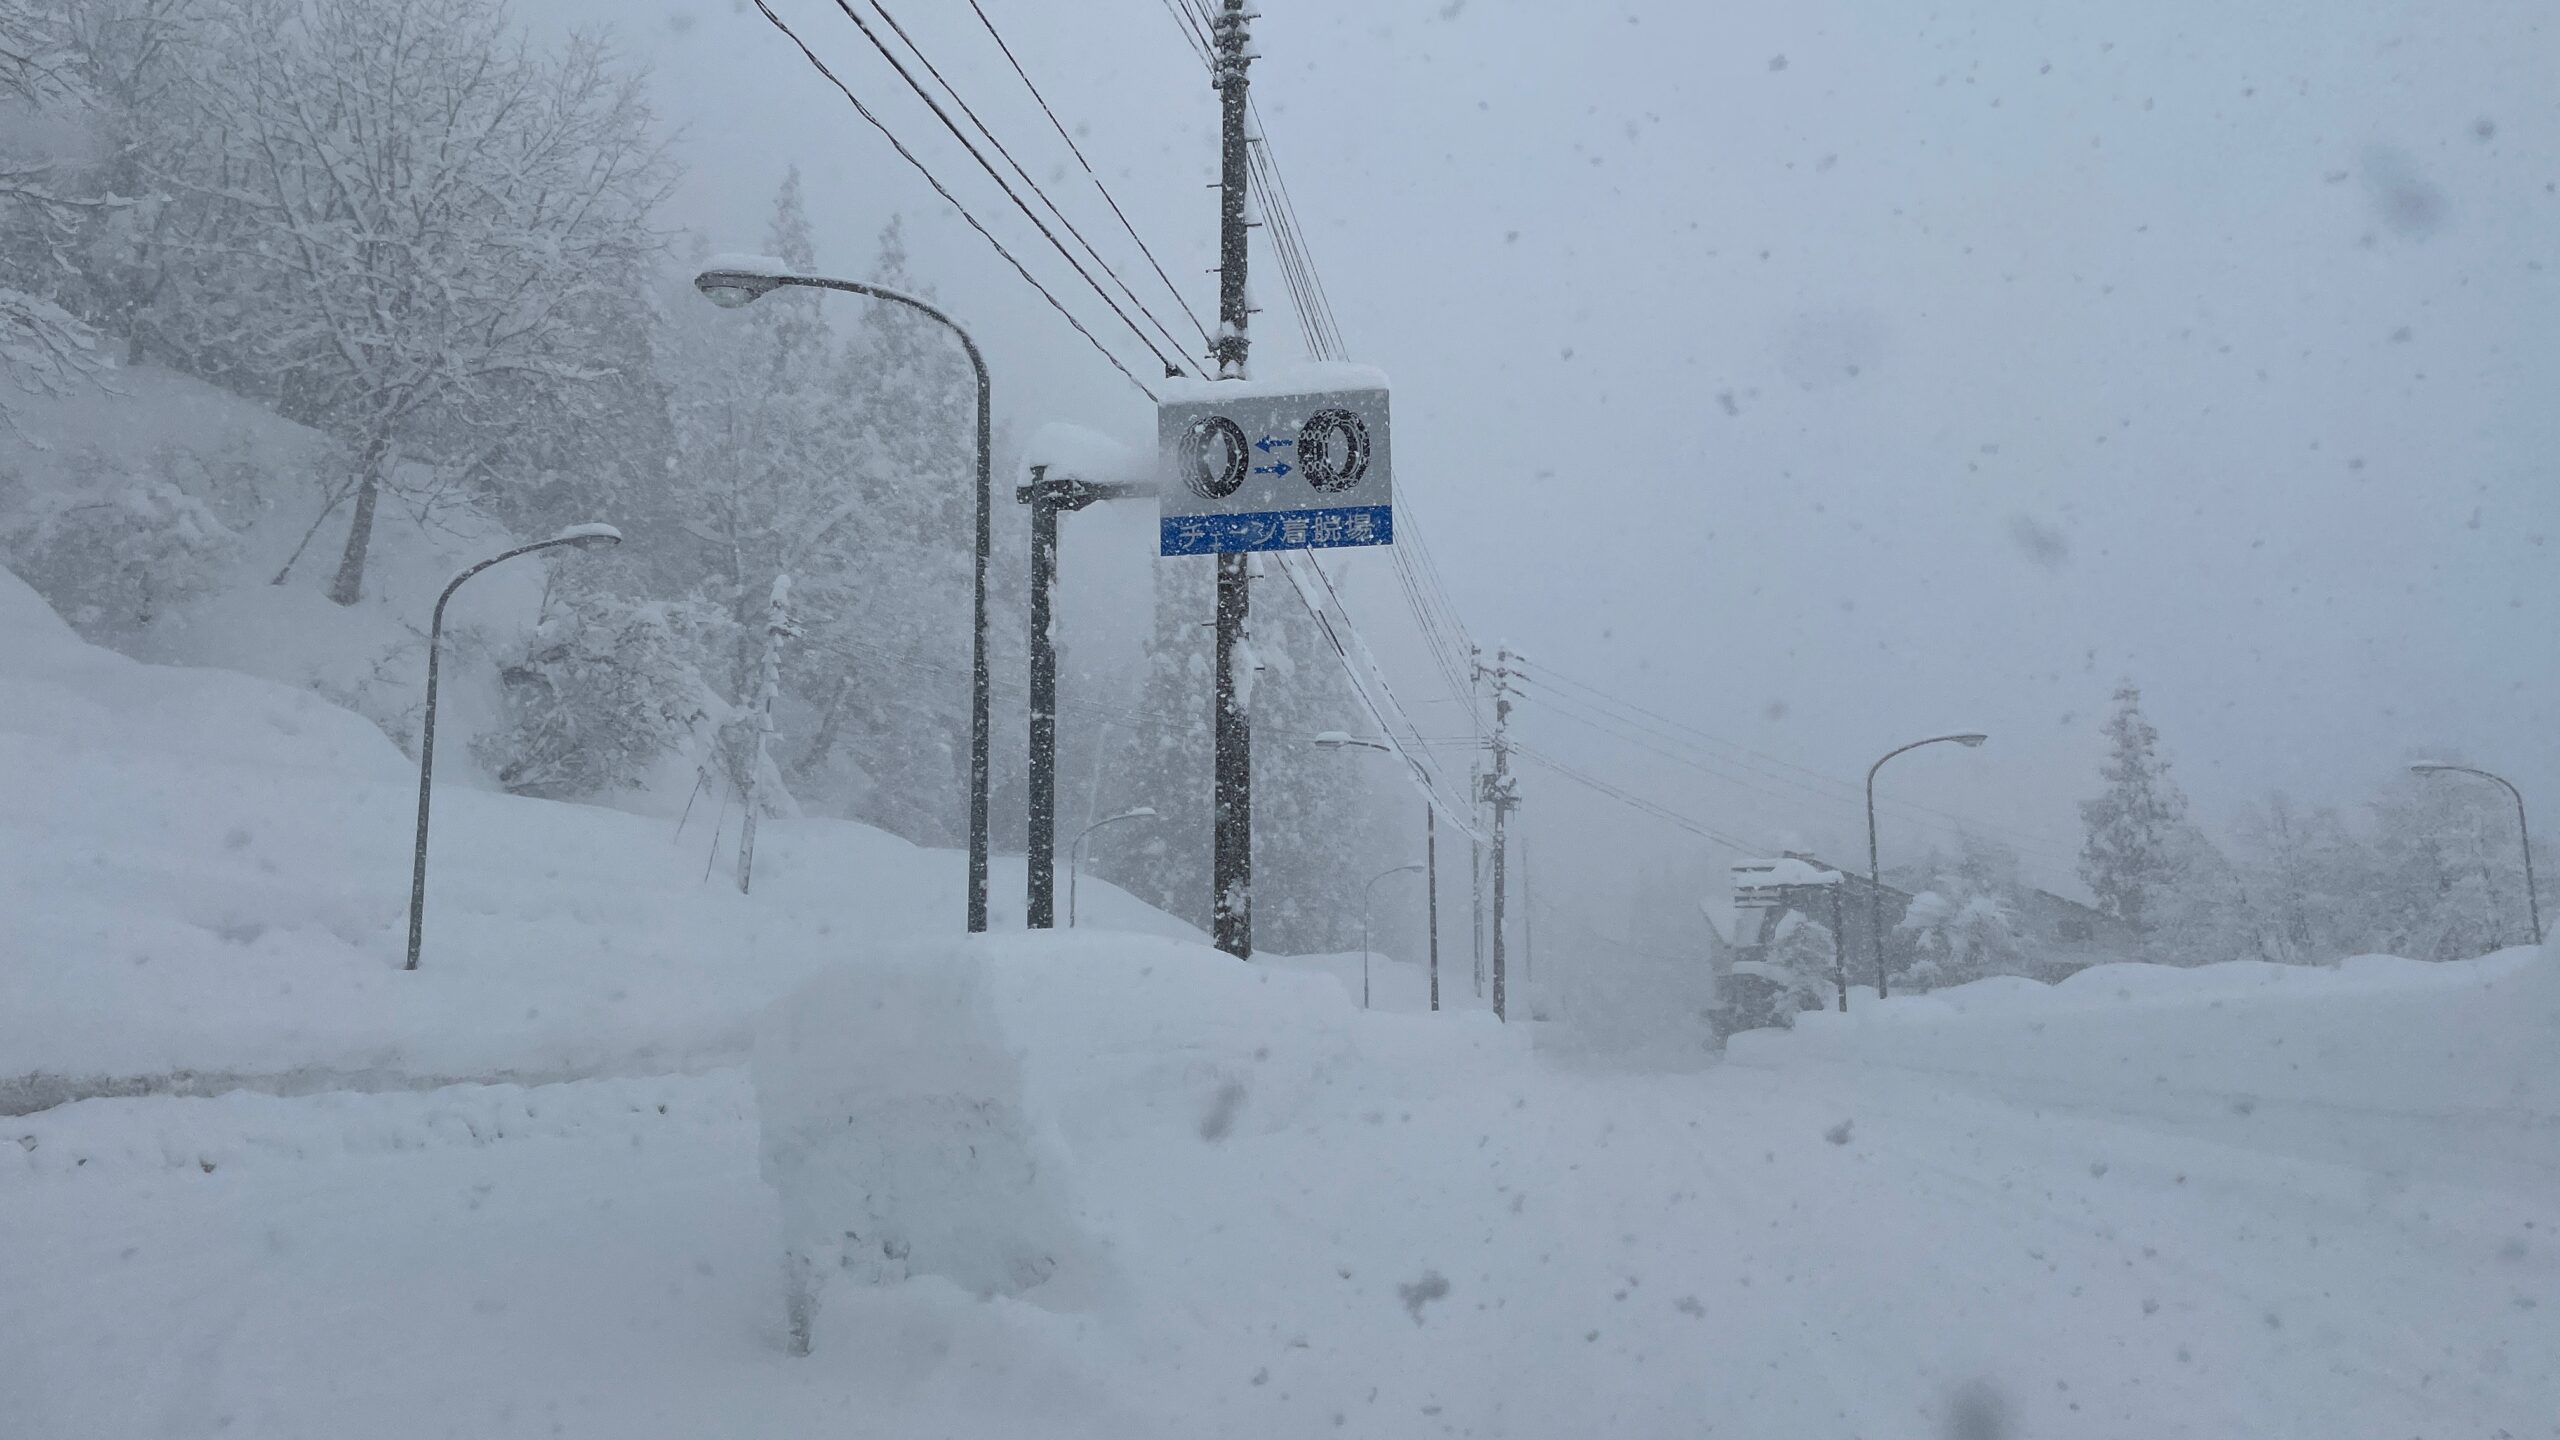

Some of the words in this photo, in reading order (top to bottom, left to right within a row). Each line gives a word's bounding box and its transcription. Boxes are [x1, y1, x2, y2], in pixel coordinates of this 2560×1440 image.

[1180, 513, 1374, 550] チェーン着脱場
